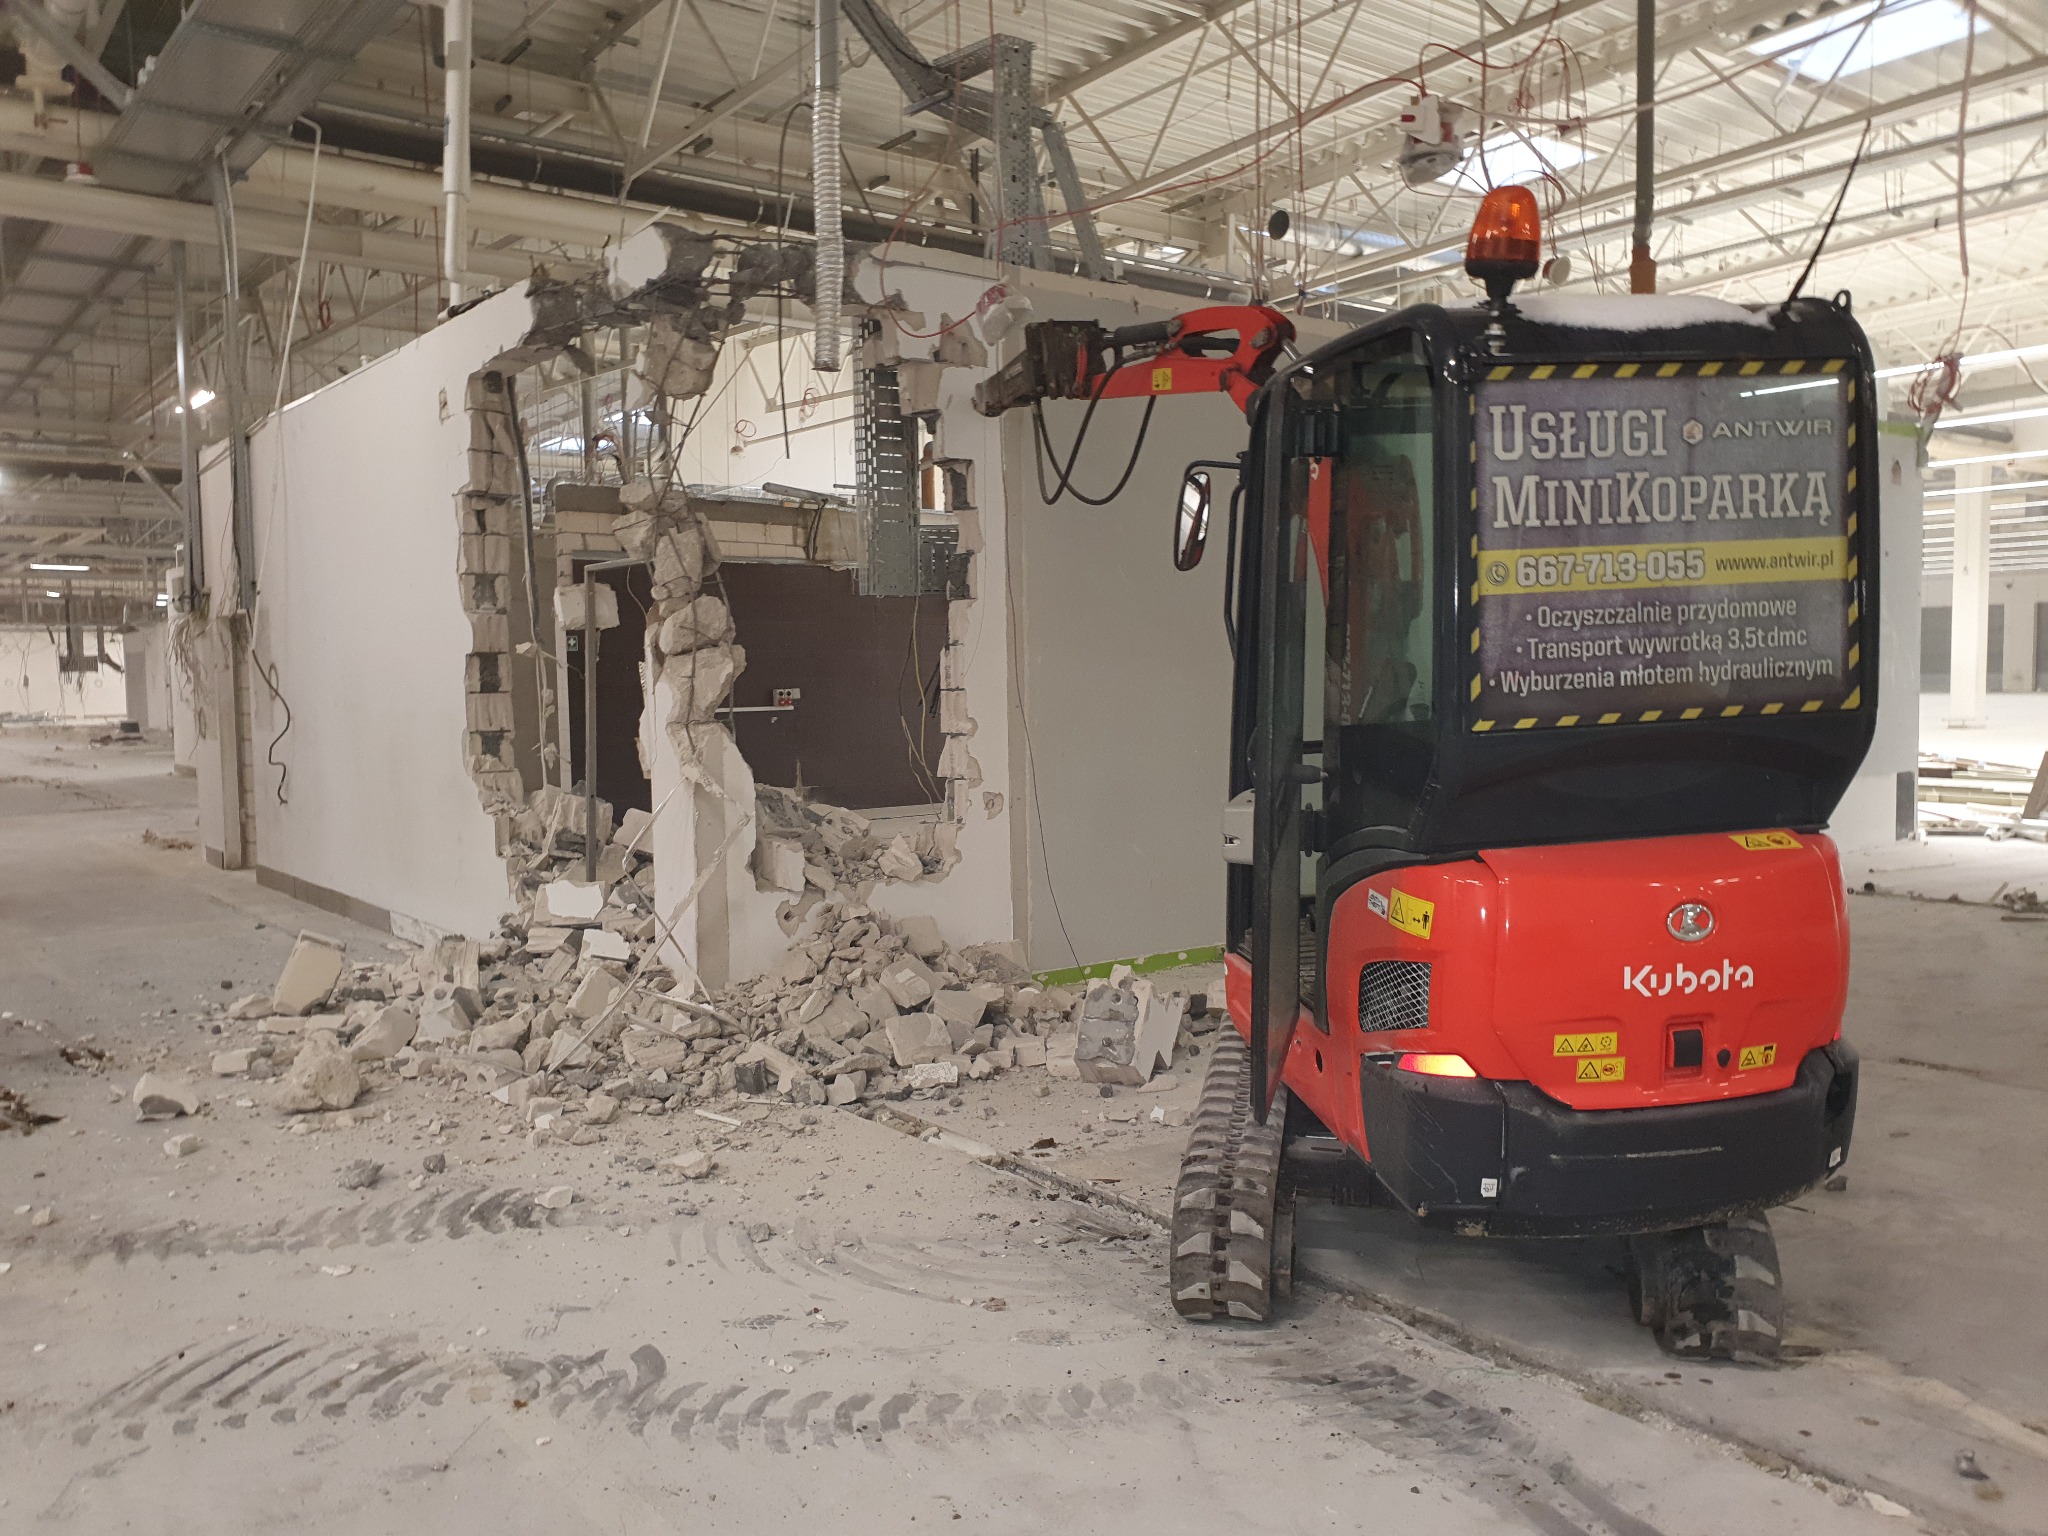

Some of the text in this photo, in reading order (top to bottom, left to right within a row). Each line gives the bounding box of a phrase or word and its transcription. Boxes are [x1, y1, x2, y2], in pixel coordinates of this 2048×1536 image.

[1712, 419, 1832, 439] ANTWIR
[1517, 549, 1705, 587] 667-713-055
[1537, 598, 1797, 632] Oczyszczalnie przydomowe
[1527, 635, 1623, 662] Transport
[1628, 630, 1723, 659] wywrotką
[1501, 656, 1833, 697] Wyburzenia młotem hydraulicznym
[1623, 958, 1754, 998] Kubota
